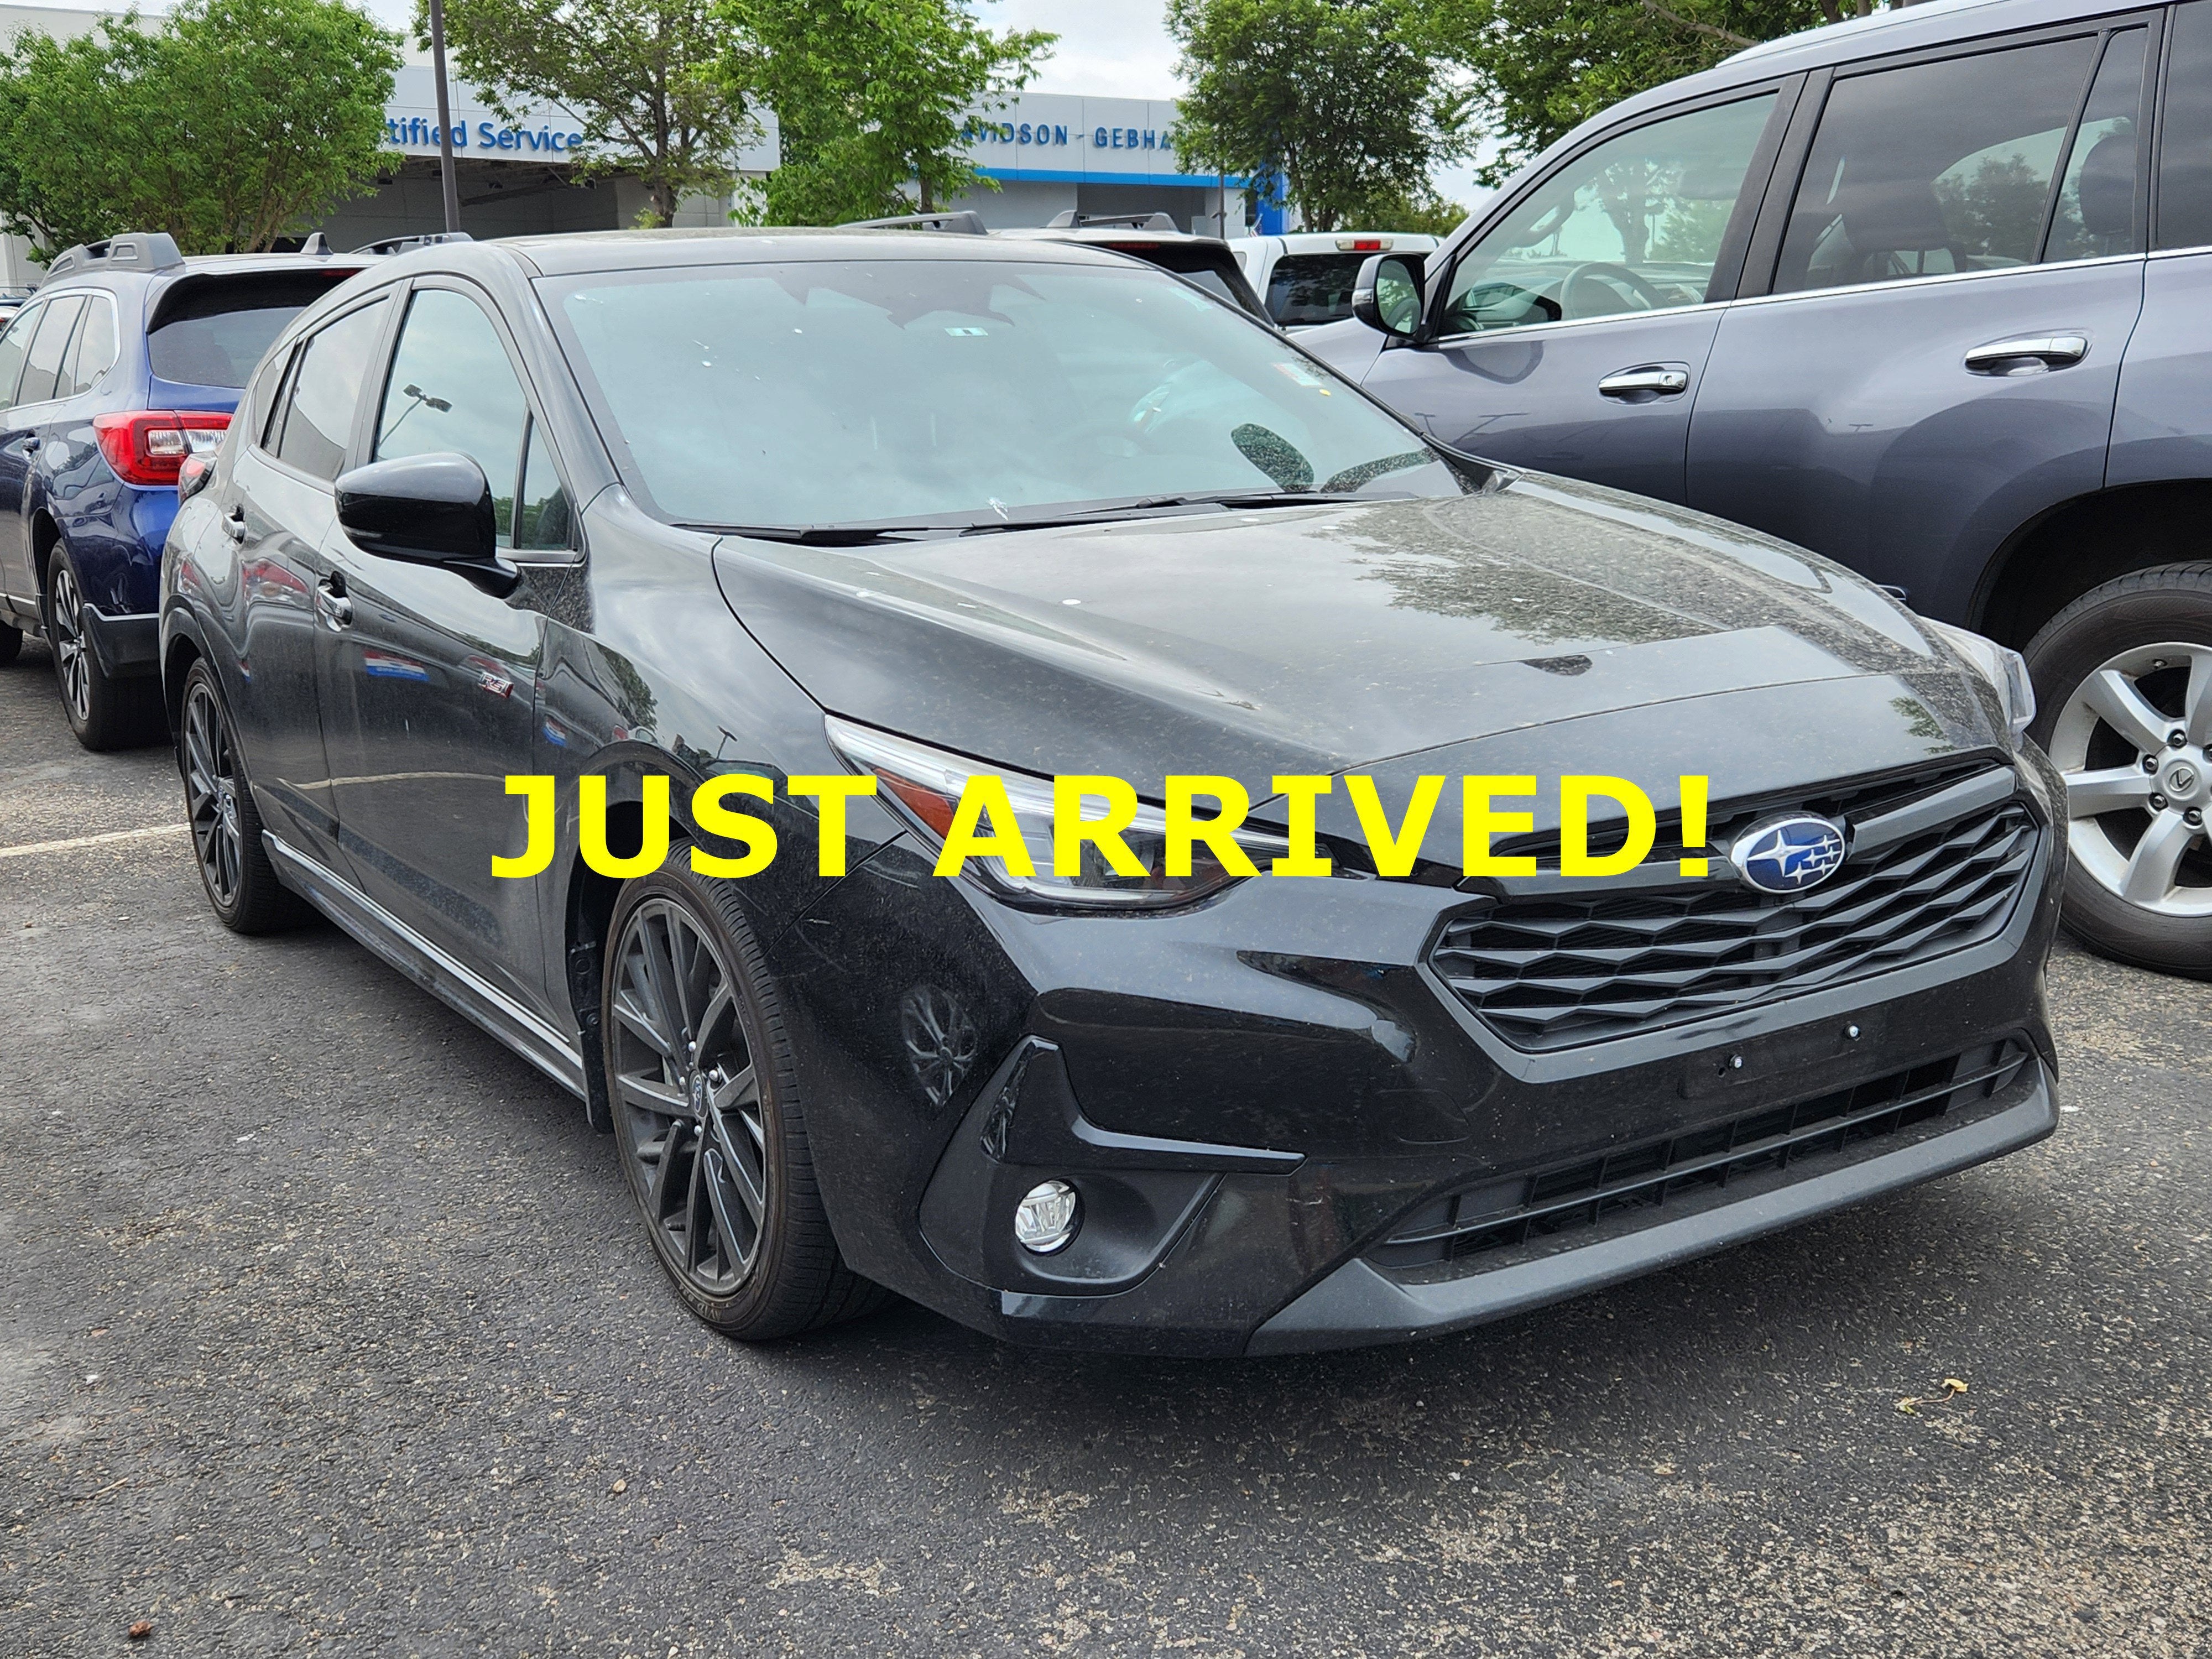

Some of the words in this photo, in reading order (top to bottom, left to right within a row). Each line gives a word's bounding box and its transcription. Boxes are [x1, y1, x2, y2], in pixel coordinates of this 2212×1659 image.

[386, 117, 467, 147] tified
[478, 122, 582, 150] Service
[961, 121, 1068, 145] AVIDSON
[1094, 127, 1171, 149] GEBHA
